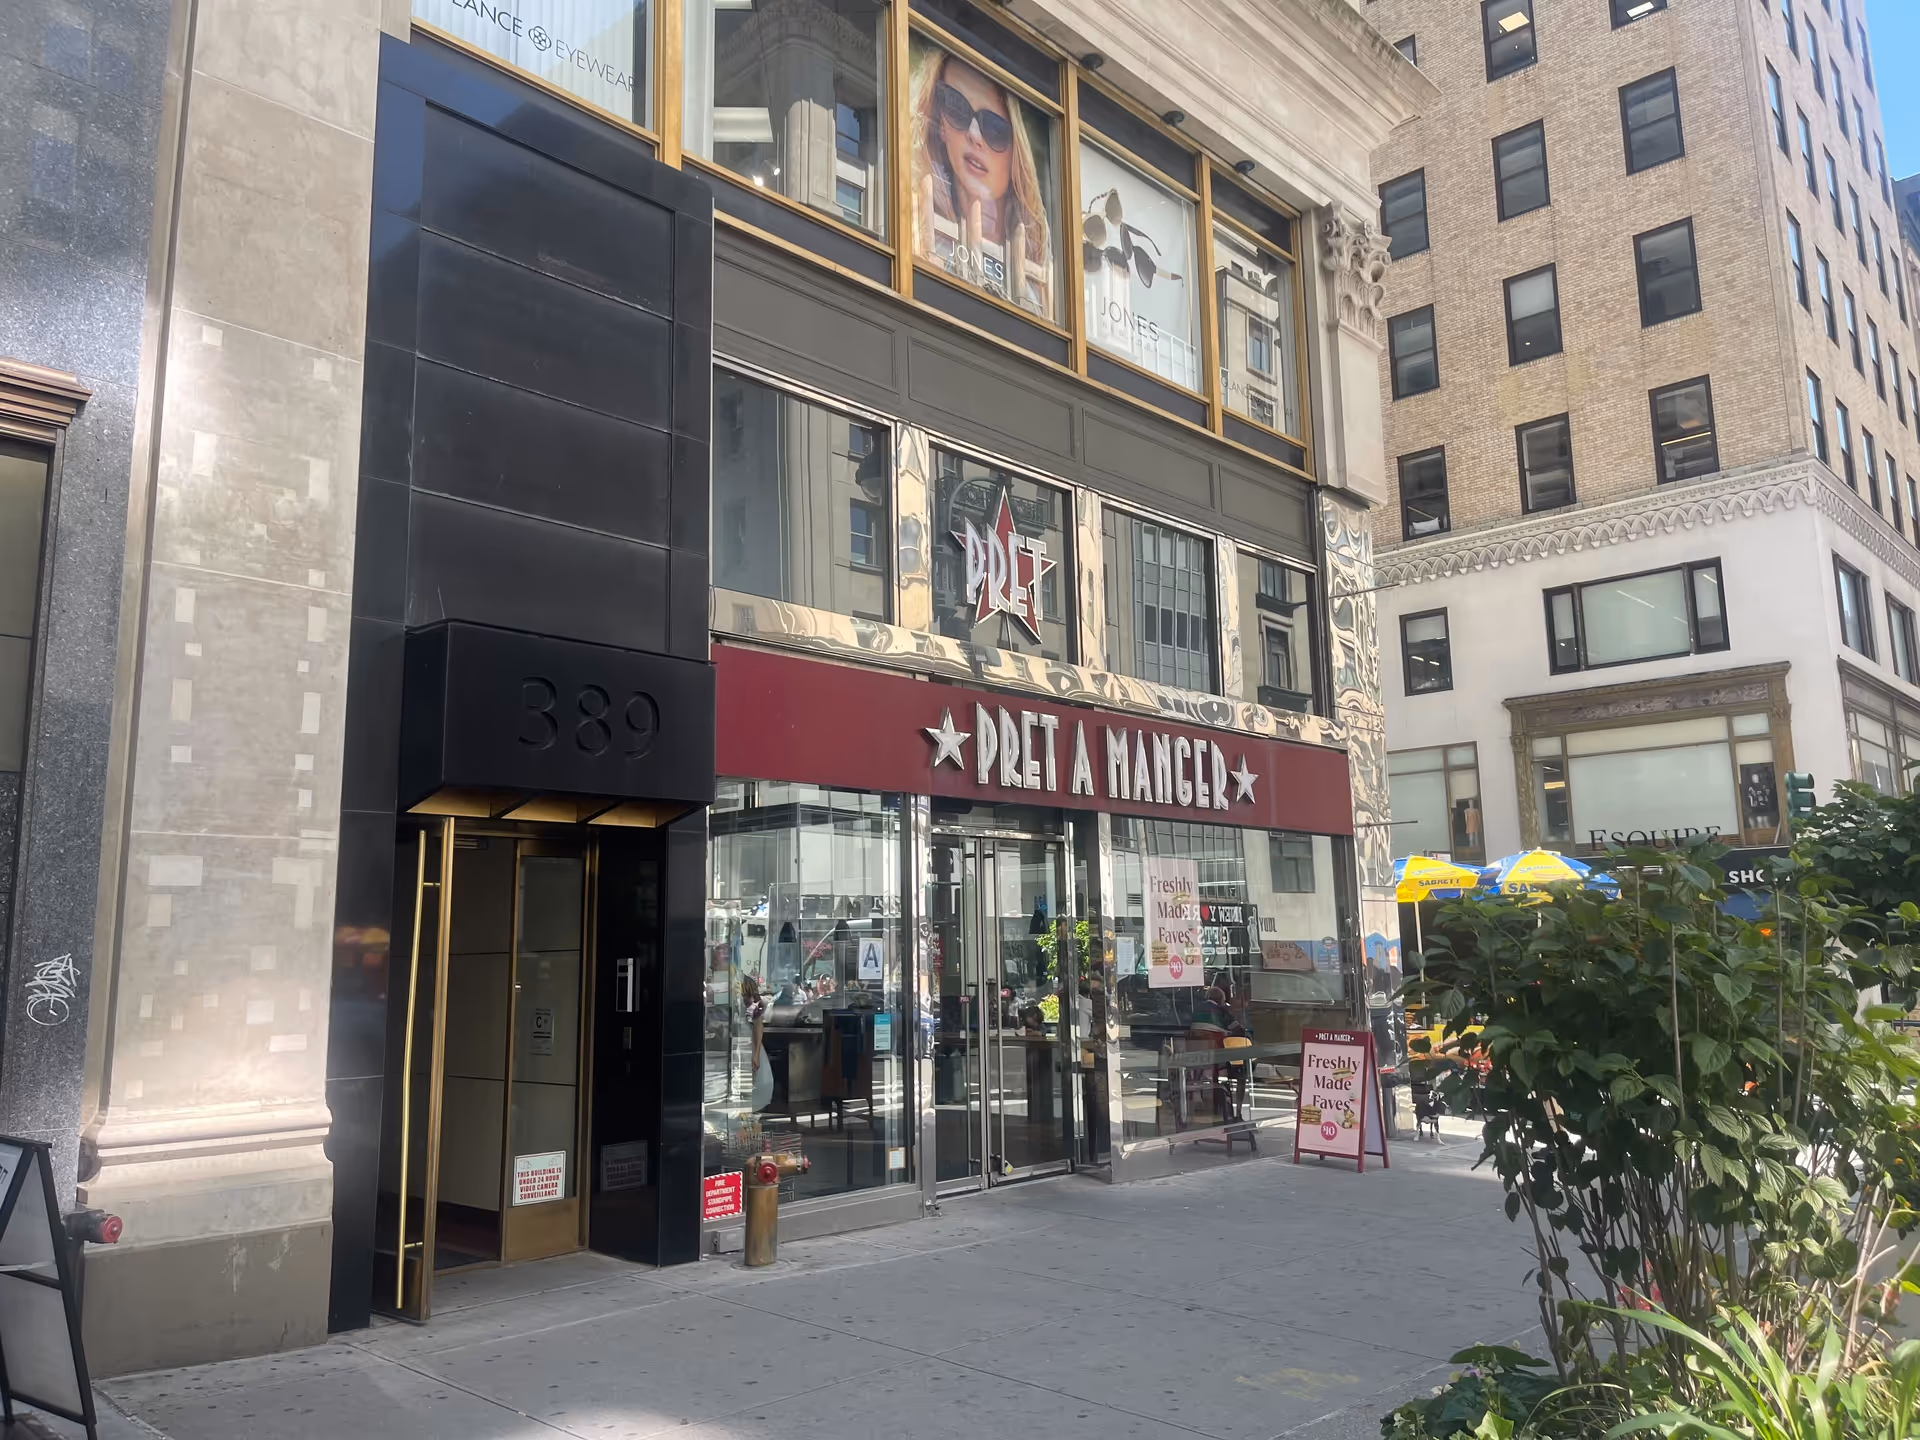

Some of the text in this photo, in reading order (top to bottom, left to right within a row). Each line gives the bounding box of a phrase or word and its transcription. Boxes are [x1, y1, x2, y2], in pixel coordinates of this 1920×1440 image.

[453, 0, 635, 92] ANCE EYEWEAR
[949, 240, 1003, 280] JONES
[1101, 296, 1159, 341] JONES
[965, 517, 1047, 620] PRET
[518, 675, 660, 759] 389
[975, 702, 1229, 811] PRET A MANGER
[1150, 876, 1193, 894] Freshly
[1157, 901, 1189, 919] Made
[1158, 927, 1191, 944] Faves
[863, 943, 879, 968] A
[1318, 1032, 1330, 1041] PRET
[1334, 1034, 1351, 1042] MANGER
[1308, 1054, 1360, 1075] Freshly
[1313, 1074, 1352, 1091] Made
[1312, 1095, 1351, 1111] Faves
[1322, 1125, 1336, 1137] $10
[531, 1168, 555, 1177] BUILDING
[537, 1182, 558, 1190] CAMERA
[714, 1179, 726, 1187] FIRE
[520, 1189, 557, 1200] SURVEILLANCE
[705, 1186, 735, 1198] DEPARTMENT
[707, 1195, 733, 1206] STANDPIPE
[705, 1203, 735, 1215] CONNECTION
